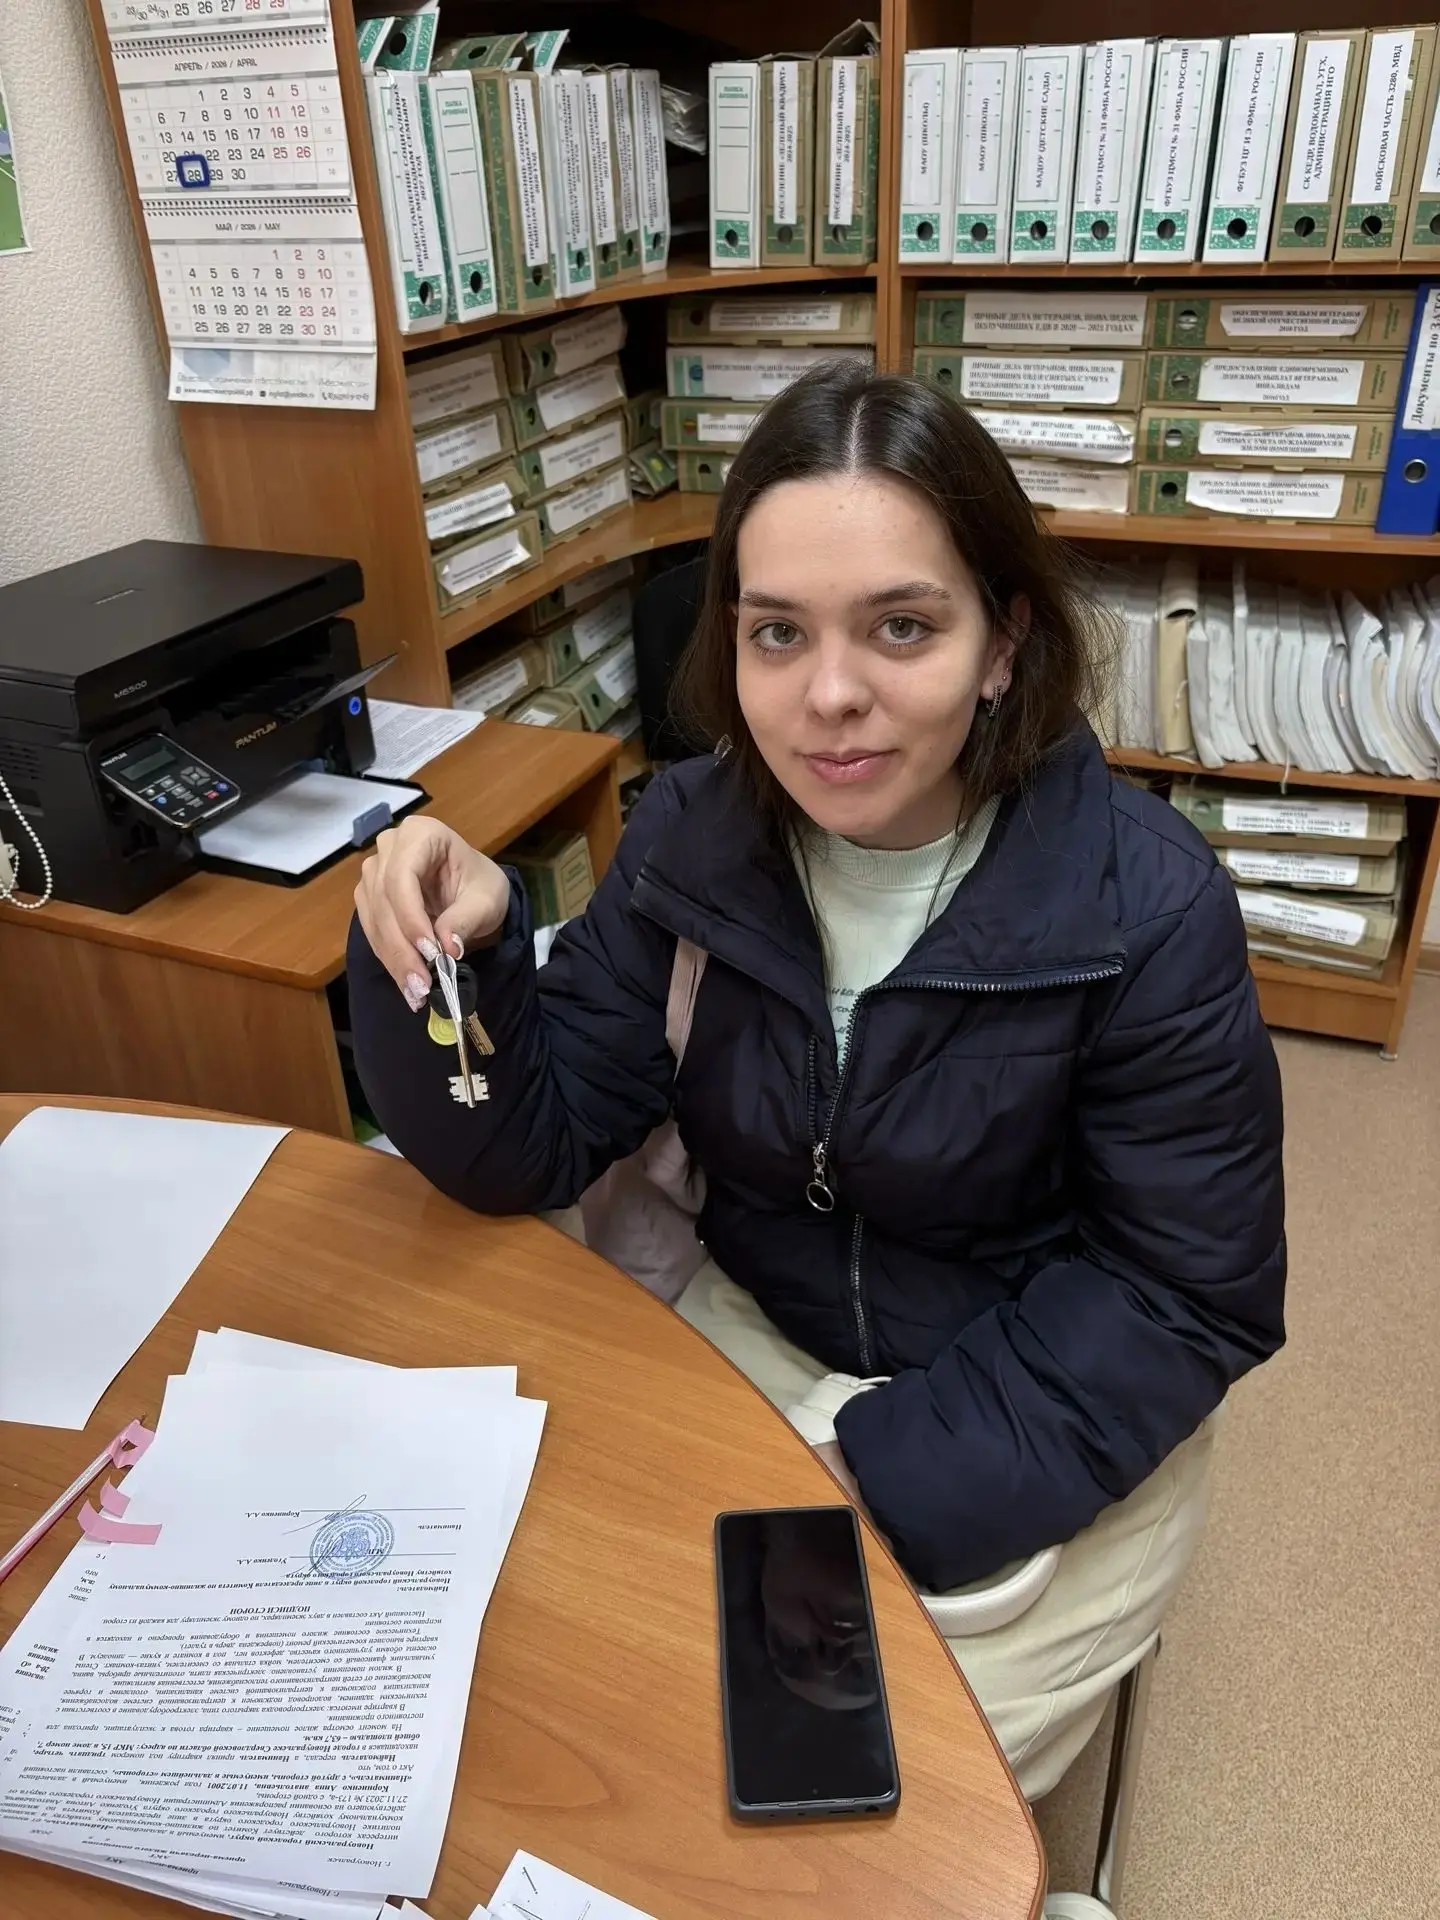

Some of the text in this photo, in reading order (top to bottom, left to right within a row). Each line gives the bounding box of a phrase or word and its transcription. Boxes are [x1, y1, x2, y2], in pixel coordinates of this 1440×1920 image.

[174, 61, 203, 72] АПРЕЛЬ
[237, 58, 258, 68] APRIL
[1251, 52, 1264, 94] РОССИИ
[198, 84, 299, 102] 1 2 3 4 5
[157, 105, 305, 125] 6 7 8 9 10 11 12
[1246, 96, 1257, 126] ФМБА
[1374, 45, 1402, 191] ВОЙСКОВАЯ ЧАСТЬ 3280, МВД
[922, 102, 930, 146] (ШКОЛЫ)
[1036, 72, 1051, 188] МАДОУ (ДЕТСКИЕ САДЫ)
[1094, 48, 1113, 204] ФГБУЗ ЦМСЧ № 31 ФМБА РОССИИ
[1164, 48, 1189, 207] ФГБУЗ ЦМСЧ № 31 ФМБА РОССИИ
[1302, 56, 1328, 189] СК КЕДР, ВОДОКАНАЛ, УГХ,
[1314, 66, 1335, 179] АДМИНИСТРАЦИЯ НГО
[160, 125, 308, 144] 13 14 15 16 17 18 19
[834, 162, 842, 219] РАССЕЛЕНИЕ
[838, 65, 846, 109] КВАДРАТ»
[978, 98, 989, 171] МАОУ (ШКОЛЫ)
[163, 151, 177, 164] 20
[206, 149, 220, 162] 22
[228, 149, 242, 161] 23
[250, 148, 265, 160] 24
[273, 147, 288, 160] 25
[296, 146, 311, 159] 26
[1240, 147, 1250, 159] ЦГ
[167, 168, 246, 182] 27 28 29 30
[415, 156, 424, 177] ГОД
[1237, 161, 1247, 192] ФГБУЗ
[215, 223, 233, 231] МАЙ
[273, 249, 325, 260] 1 2 3
[189, 268, 332, 279] 4 5 6 7 8 9 10
[190, 286, 333, 298] 11 12 13 14 15 16 17
[1411, 352, 1435, 424] Документы
[1429, 334, 1439, 348] по
[114, 680, 147, 699] M6500
[235, 721, 277, 749] PANTUM
[230, 1607, 266, 1615] СТОРОН
[260, 1614, 307, 1622] экземплярах,
[385, 1610, 425, 1618] Настоящий
[404, 1618, 441, 1626] исправном
[327, 1713, 424, 1722] постоянного проживания.
[350, 1734, 392, 1742] площадью
[394, 1733, 420, 1741] общей
[327, 1857, 382, 1867] Новоуральск
[277, 1880, 340, 1898] г. Новоуральск
